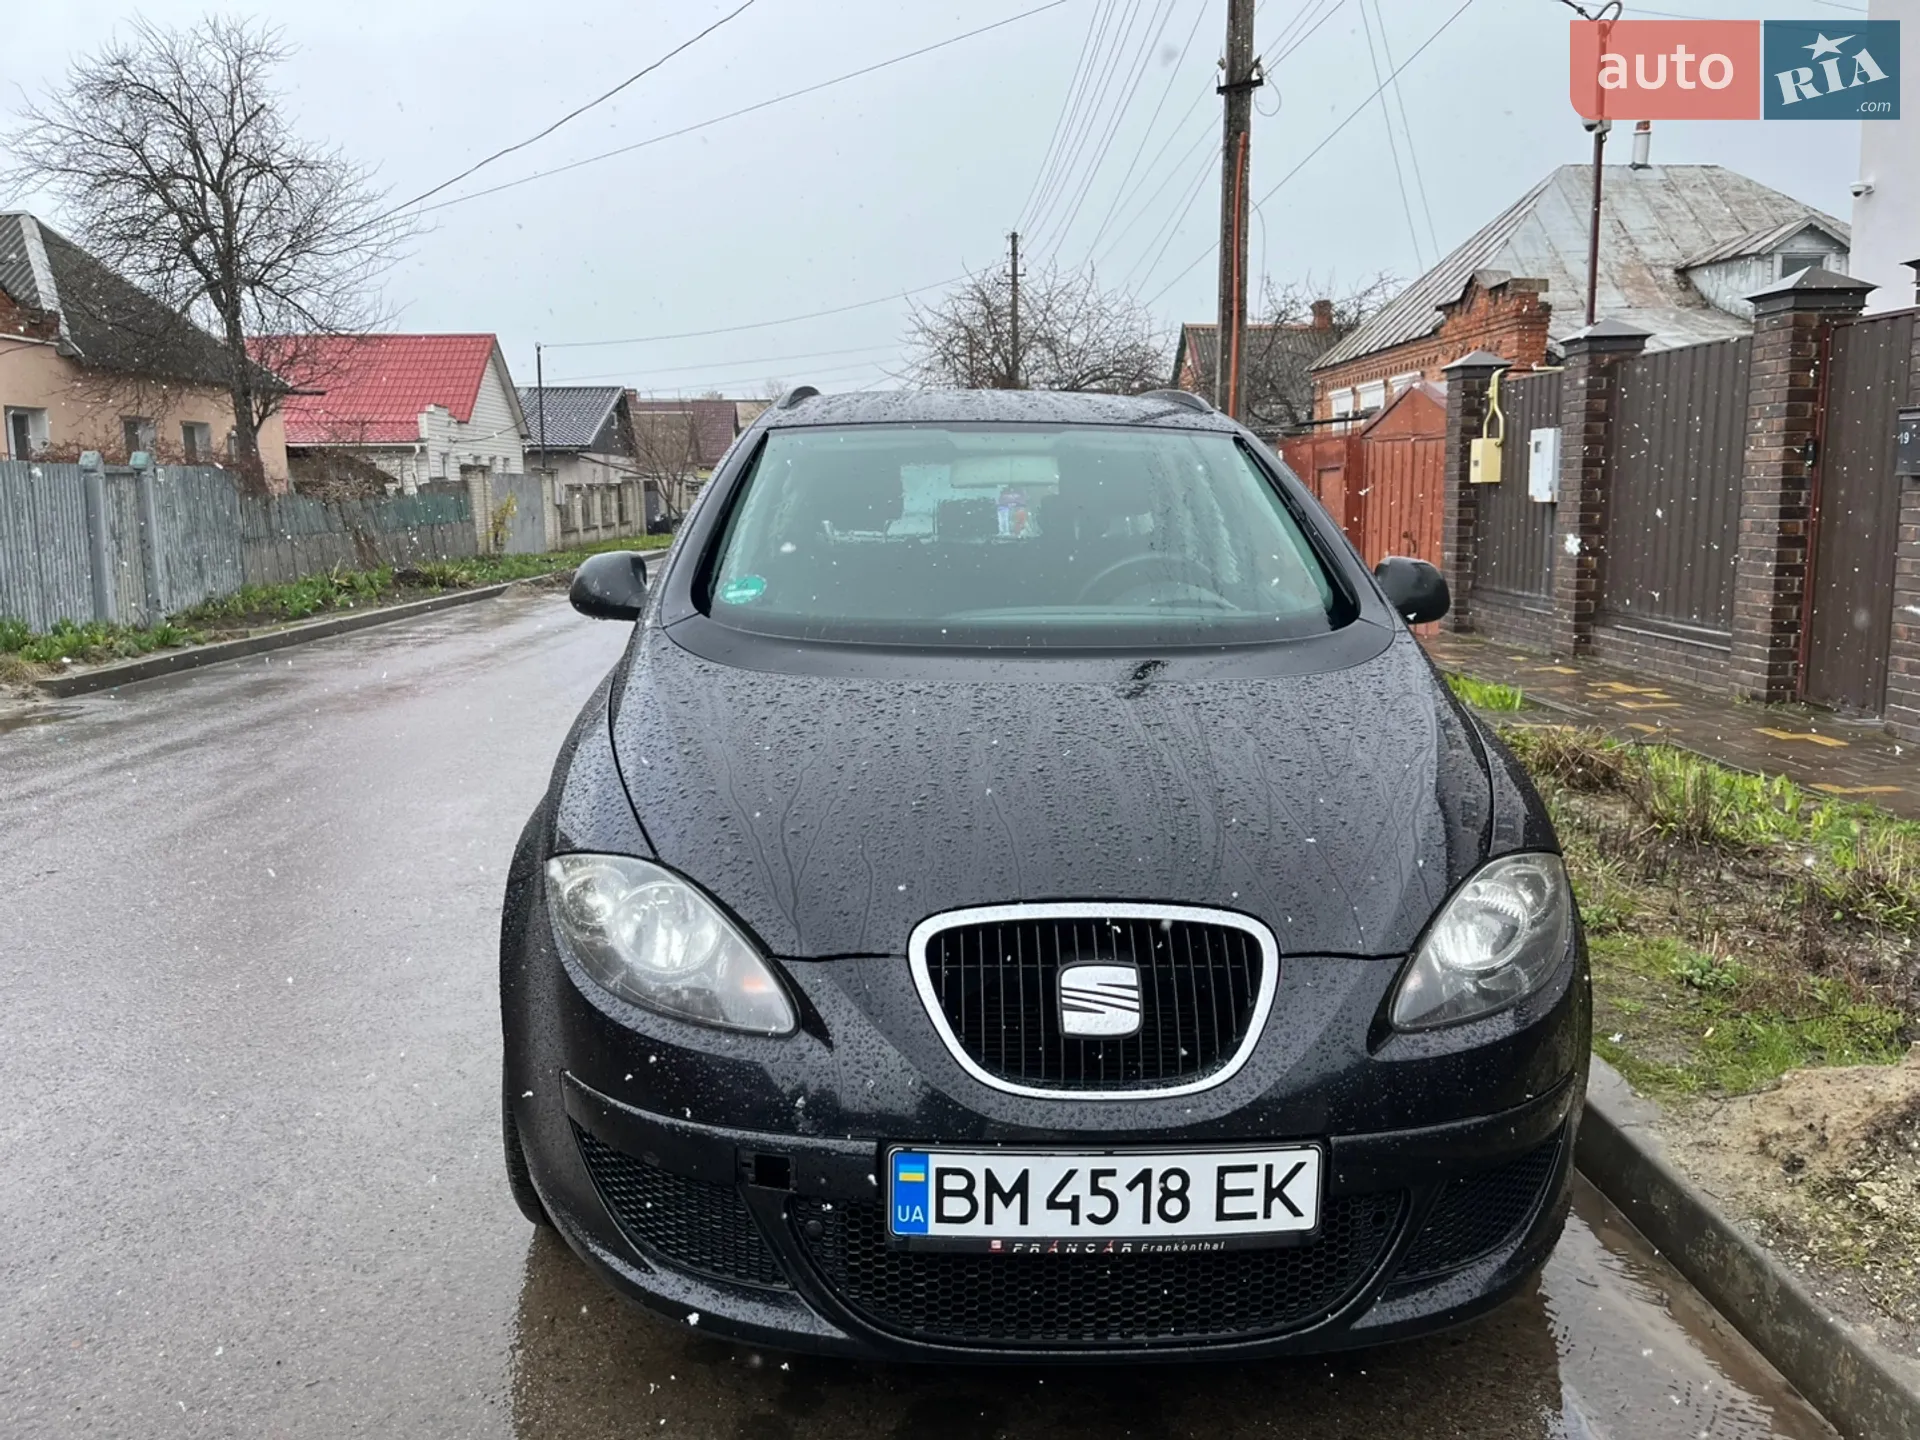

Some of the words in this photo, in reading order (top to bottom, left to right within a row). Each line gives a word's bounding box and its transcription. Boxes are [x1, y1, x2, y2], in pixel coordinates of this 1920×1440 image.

[934, 1167, 1029, 1225] BM
[1046, 1167, 1191, 1226] 4518
[1216, 1161, 1307, 1221] EK
[897, 1204, 926, 1223] UA
[1140, 1241, 1226, 1252] Frankenthal
